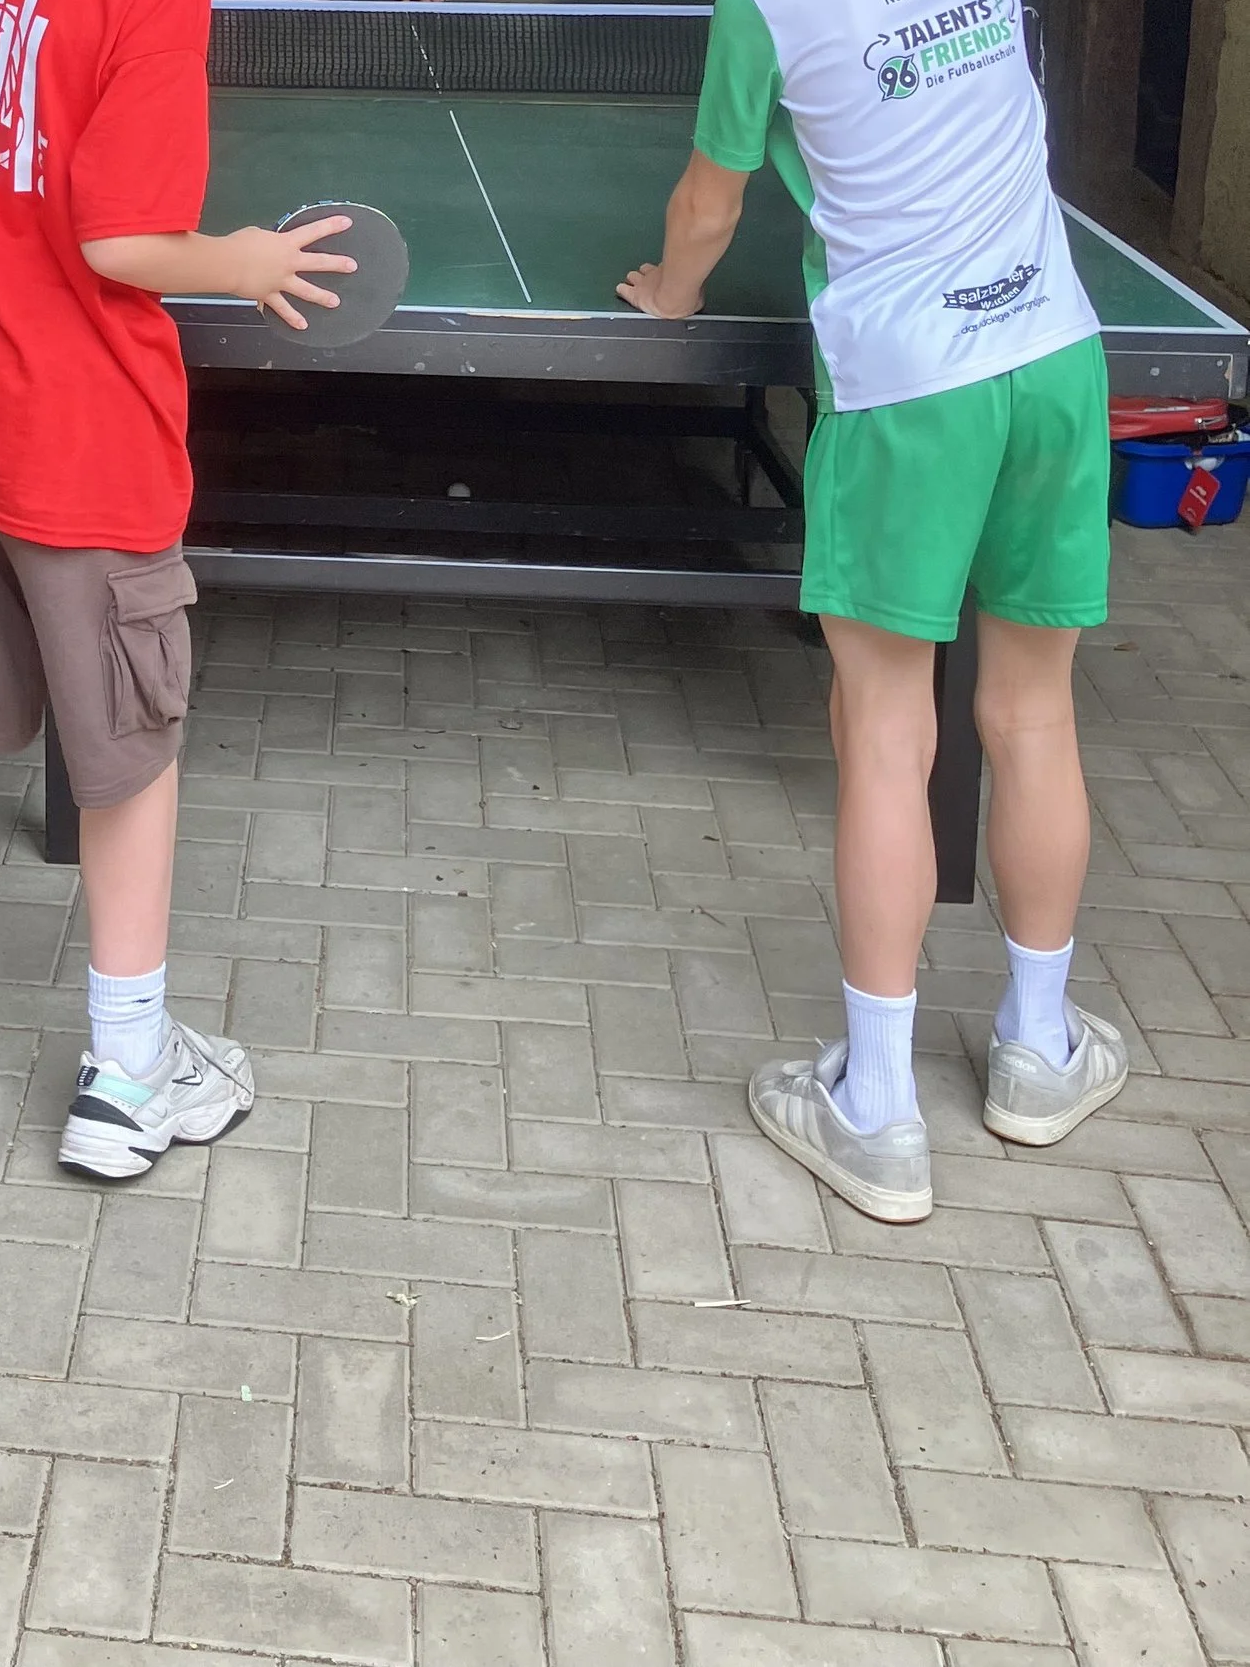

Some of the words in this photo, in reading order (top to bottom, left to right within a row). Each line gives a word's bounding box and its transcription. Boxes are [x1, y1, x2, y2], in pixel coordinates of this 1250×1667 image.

[920, 17, 1012, 73] FRIENDS
[926, 76, 945, 88] Die
[948, 45, 1017, 80] Fußballschule
[881, 59, 917, 97] 96
